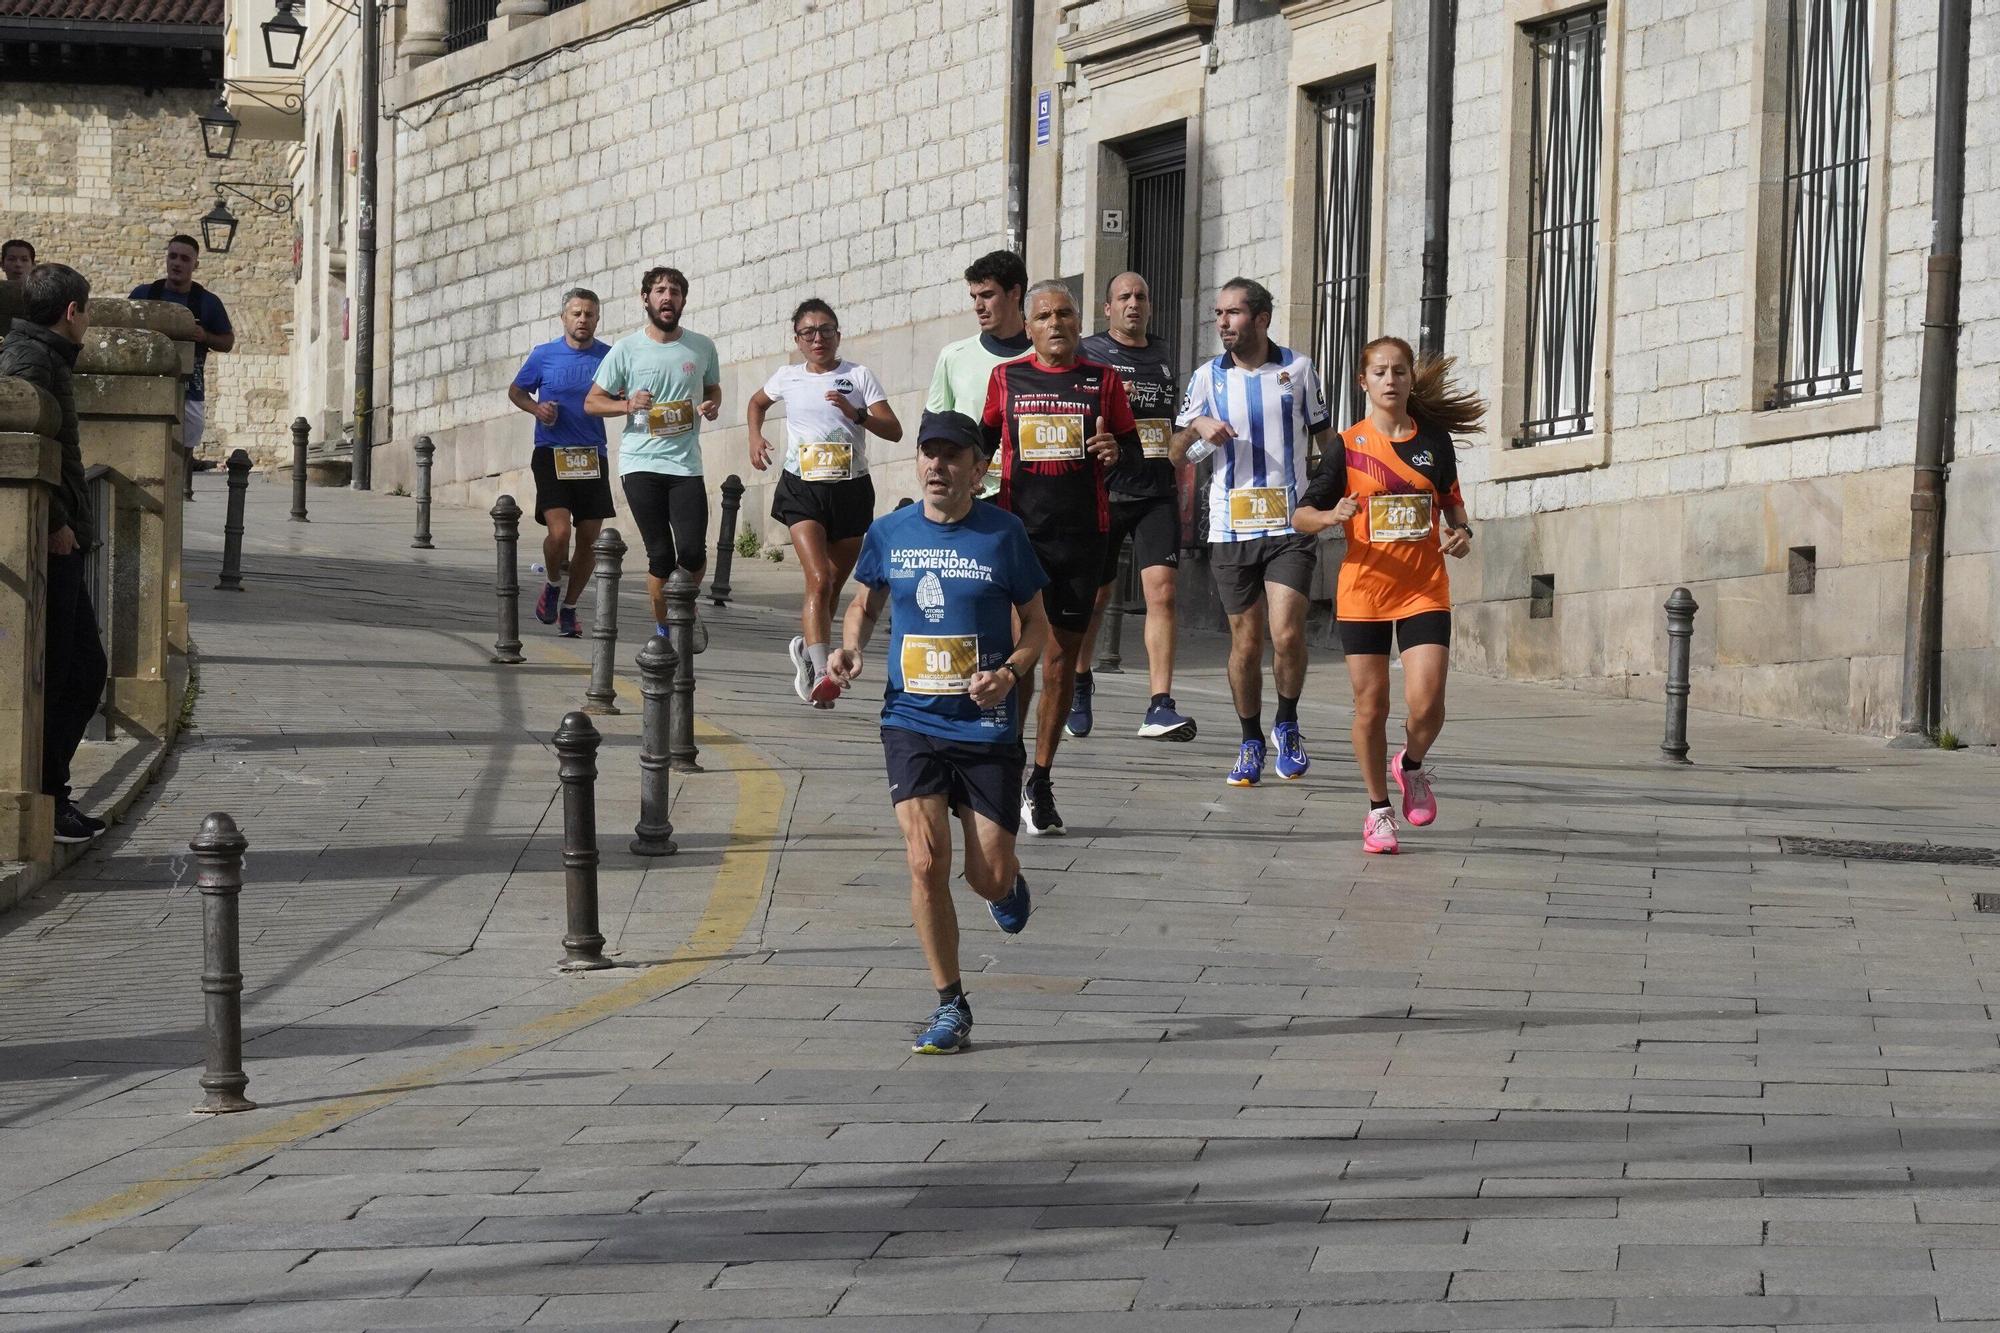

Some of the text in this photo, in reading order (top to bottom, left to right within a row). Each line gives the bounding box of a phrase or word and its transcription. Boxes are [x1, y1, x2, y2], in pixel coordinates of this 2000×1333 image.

[662, 409, 682, 423] 191
[1035, 426, 1067, 443] 600
[1140, 428, 1163, 443] 295
[566, 454, 588, 468] 546
[1249, 497, 1267, 513] 78
[890, 549, 958, 558] LA CONQUISTA
[902, 558, 978, 570] ALMENDRA
[941, 569, 993, 582] KONKISTA
[926, 650, 952, 672] 90
